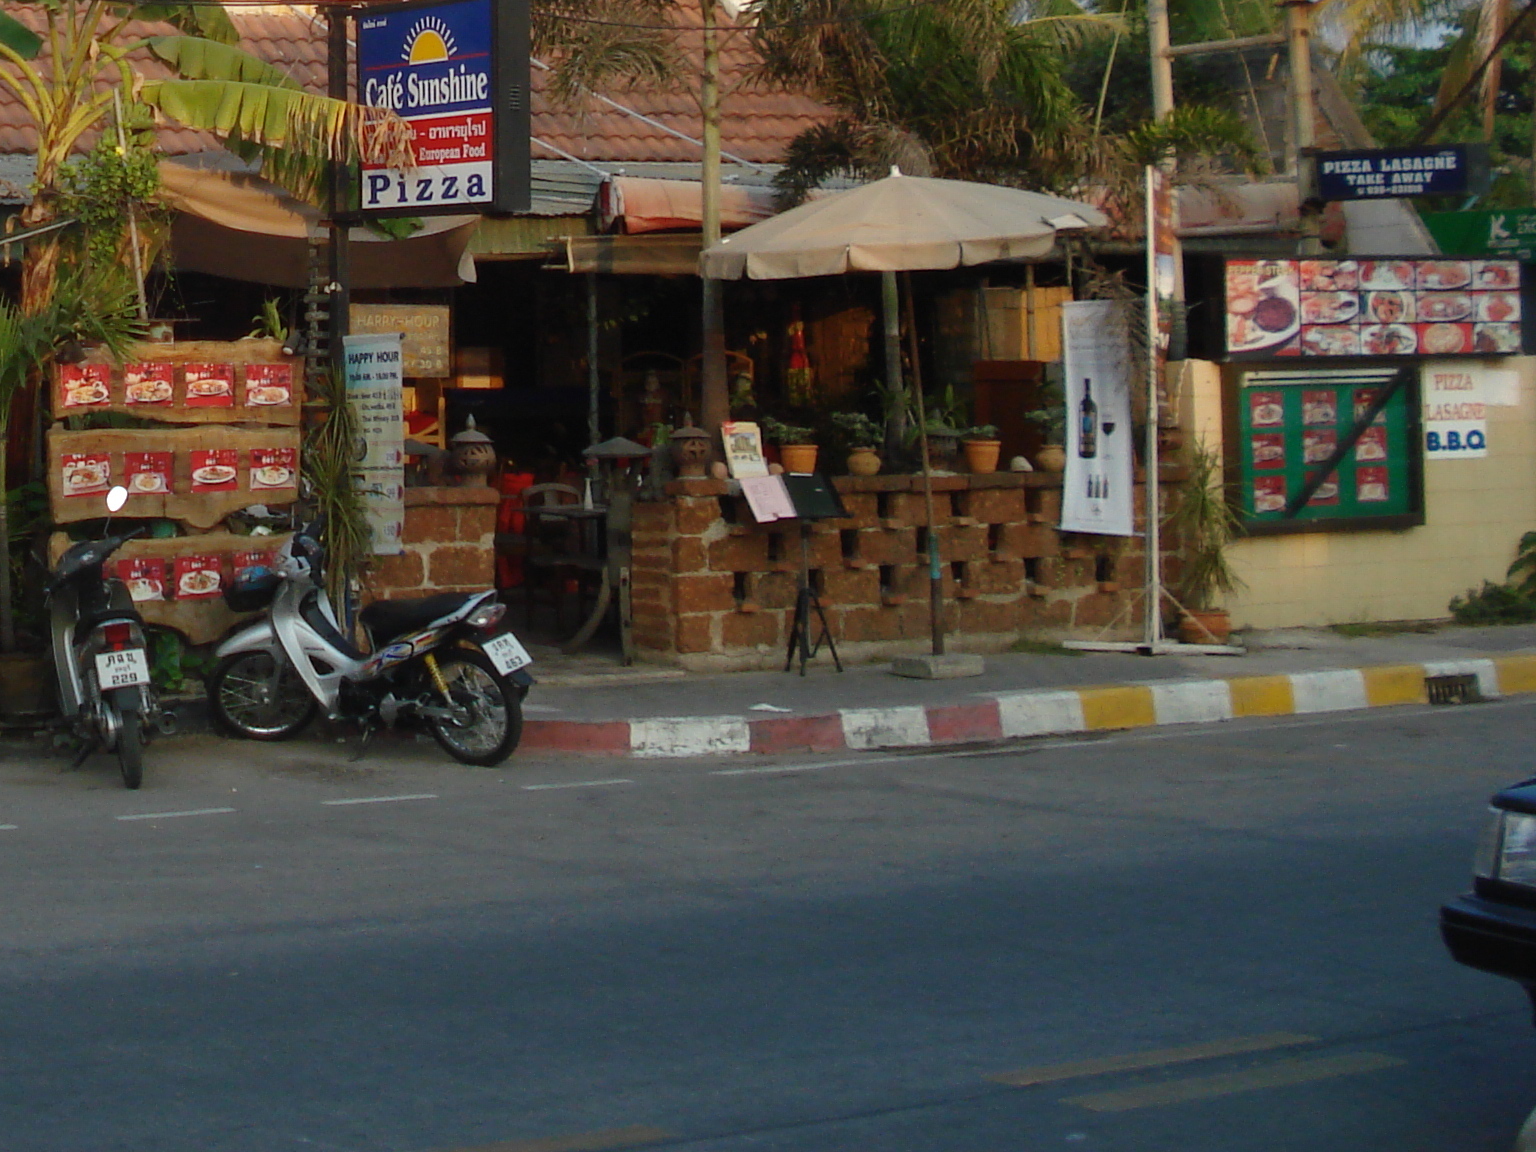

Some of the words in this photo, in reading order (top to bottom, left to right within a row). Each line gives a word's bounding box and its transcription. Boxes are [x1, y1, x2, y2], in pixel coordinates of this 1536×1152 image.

[366, 71, 404, 109] Café
[407, 64, 488, 108] Sunshine
[428, 117, 486, 142] อาหารยุโรป
[419, 147, 461, 164] European
[462, 142, 486, 158] Food
[1323, 159, 1373, 175] PIZZA
[1380, 155, 1457, 173] LASAGNE
[1345, 173, 1385, 186] TAKE
[1391, 171, 1434, 184] AWAY
[367, 173, 486, 205] Pizza
[348, 352, 374, 364] HAPPY
[376, 351, 399, 363] HOUR
[1433, 373, 1474, 391] PIZZA
[1425, 402, 1486, 421] LASAGNE
[1426, 429, 1486, 452] B.B.Q
[111, 672, 138, 685] 229
